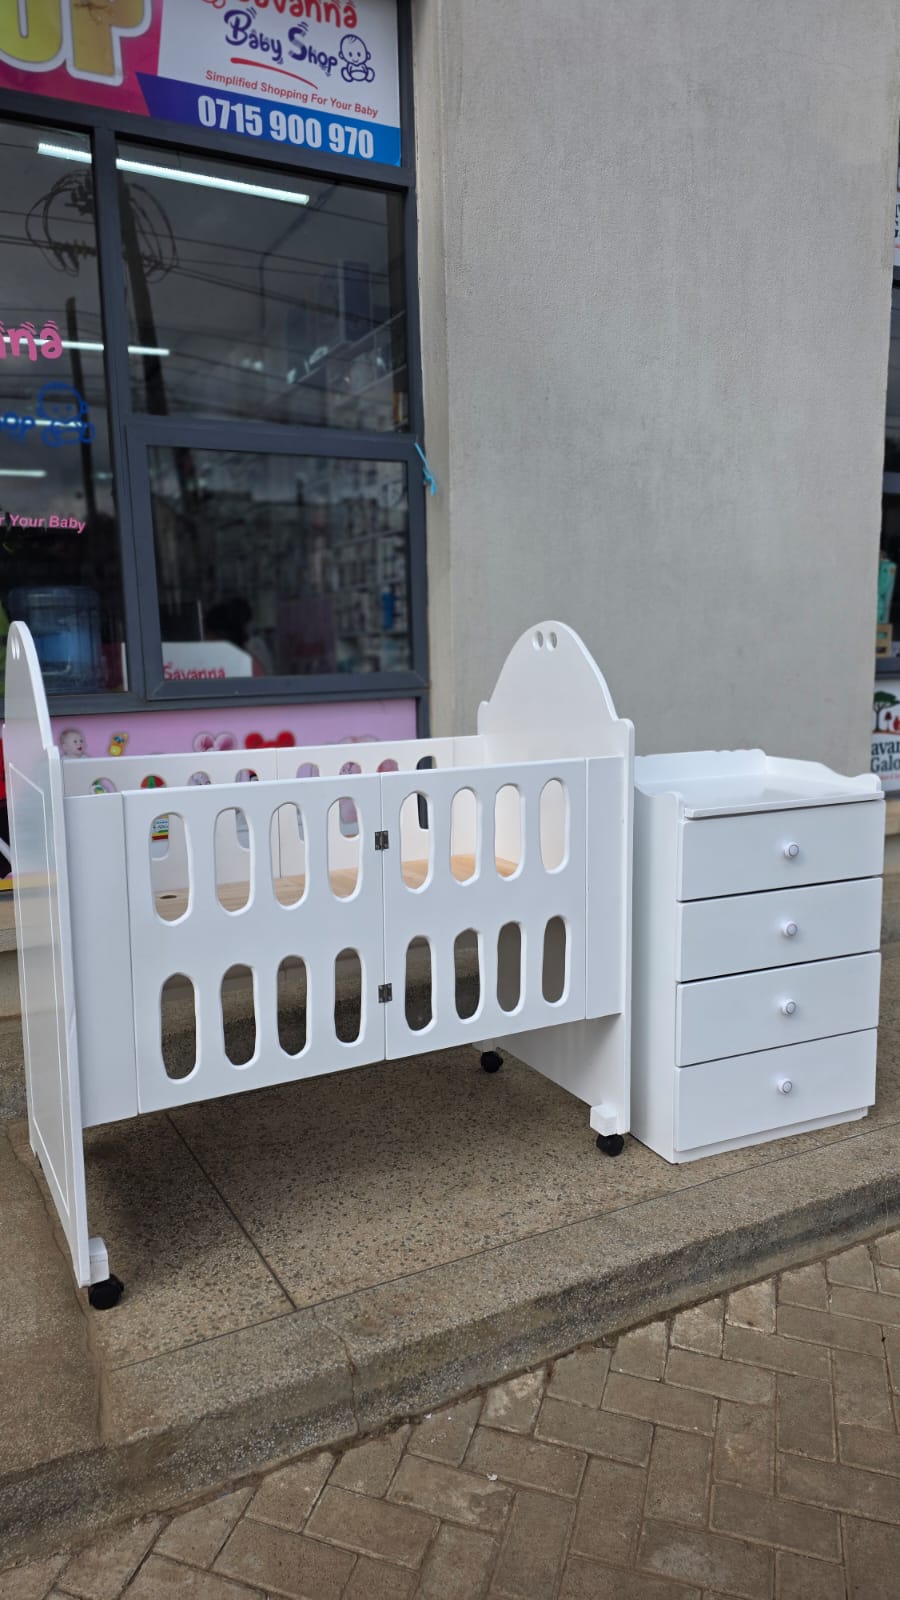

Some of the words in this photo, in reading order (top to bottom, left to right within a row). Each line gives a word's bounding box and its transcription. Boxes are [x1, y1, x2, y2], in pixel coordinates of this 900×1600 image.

[238, 0, 357, 29] vanna
[224, 9, 283, 63] Baby
[288, 26, 338, 75] Shop
[205, 70, 258, 90] Simplified
[260, 82, 309, 103] Shopping
[311, 93, 327, 105] For
[330, 97, 352, 111] Your
[354, 103, 379, 119] Baby
[198, 95, 263, 137] 0715
[269, 110, 322, 148] 900
[328, 123, 374, 159] 970
[0, 325, 63, 362] na
[10, 514, 46, 528] Your
[49, 514, 86, 534] Baby
